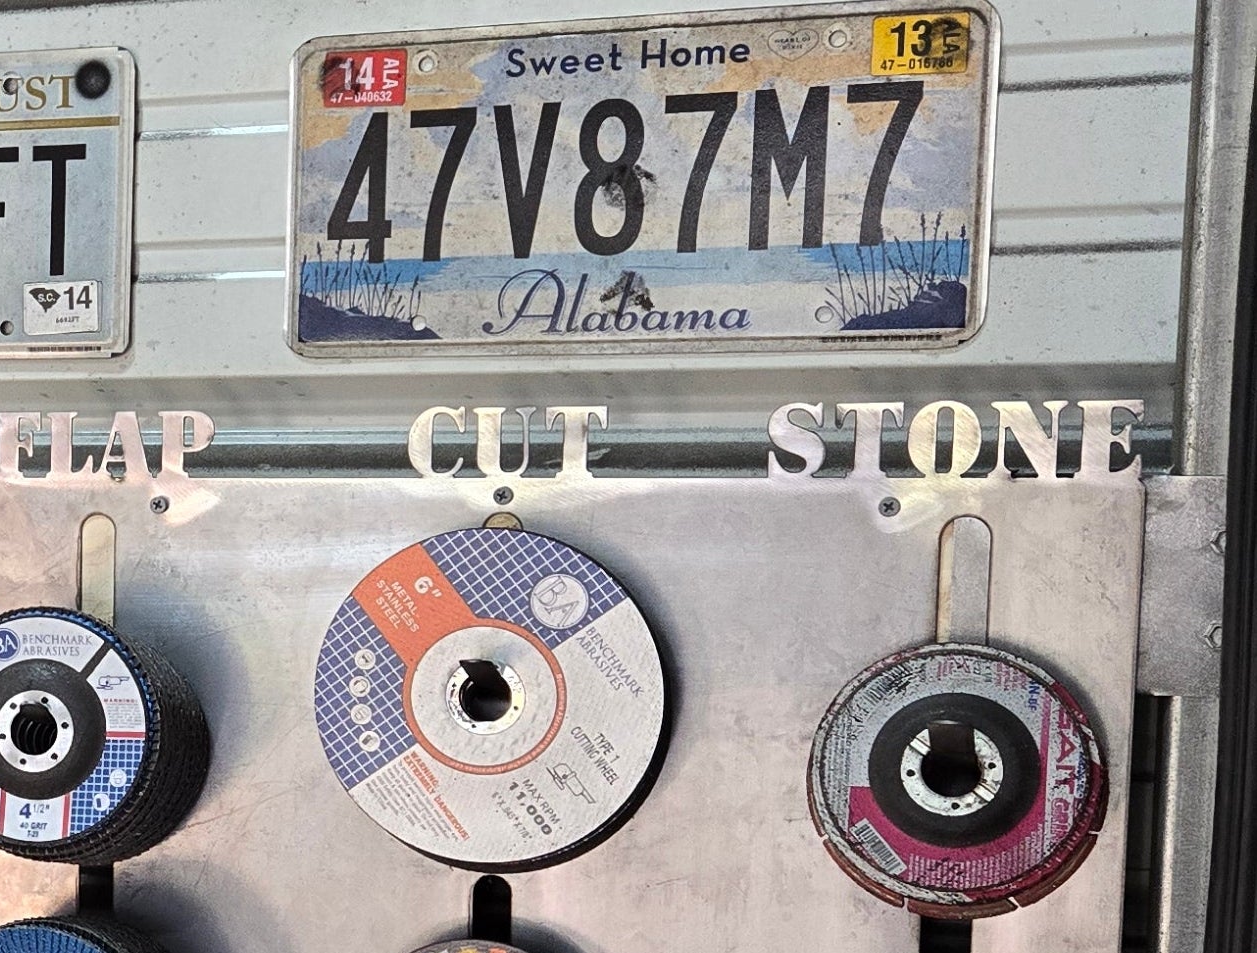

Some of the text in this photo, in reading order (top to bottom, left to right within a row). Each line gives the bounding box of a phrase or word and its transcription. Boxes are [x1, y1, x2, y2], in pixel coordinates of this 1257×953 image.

[504, 48, 623, 79] Sweet
[640, 40, 751, 70] Home
[890, 20, 932, 57] 13
[339, 57, 375, 91] 14
[382, 58, 399, 90] ALA
[327, 81, 925, 264] 47V87M7
[63, 285, 93, 310] 14
[482, 268, 752, 336] Alabama
[408, 404, 610, 478] CUT
[767, 400, 1145, 478] STONE
[375, 596, 401, 630] STEEL
[376, 579, 420, 633] STAINLESS
[533, 575, 581, 628] BA
[22, 634, 93, 646] BENCHMARK
[23, 646, 81, 657] ABRASIVES
[575, 635, 625, 692] ABRASIVES
[585, 626, 644, 698] BENCHMARK
[570, 726, 620, 786] CUTTING WHEEL
[594, 732, 615, 756] TYPE
[19, 803, 32, 819] 4
[508, 779, 554, 838] 11,000
[522, 778, 543, 803] MAX
[540, 800, 561, 825] RPM
